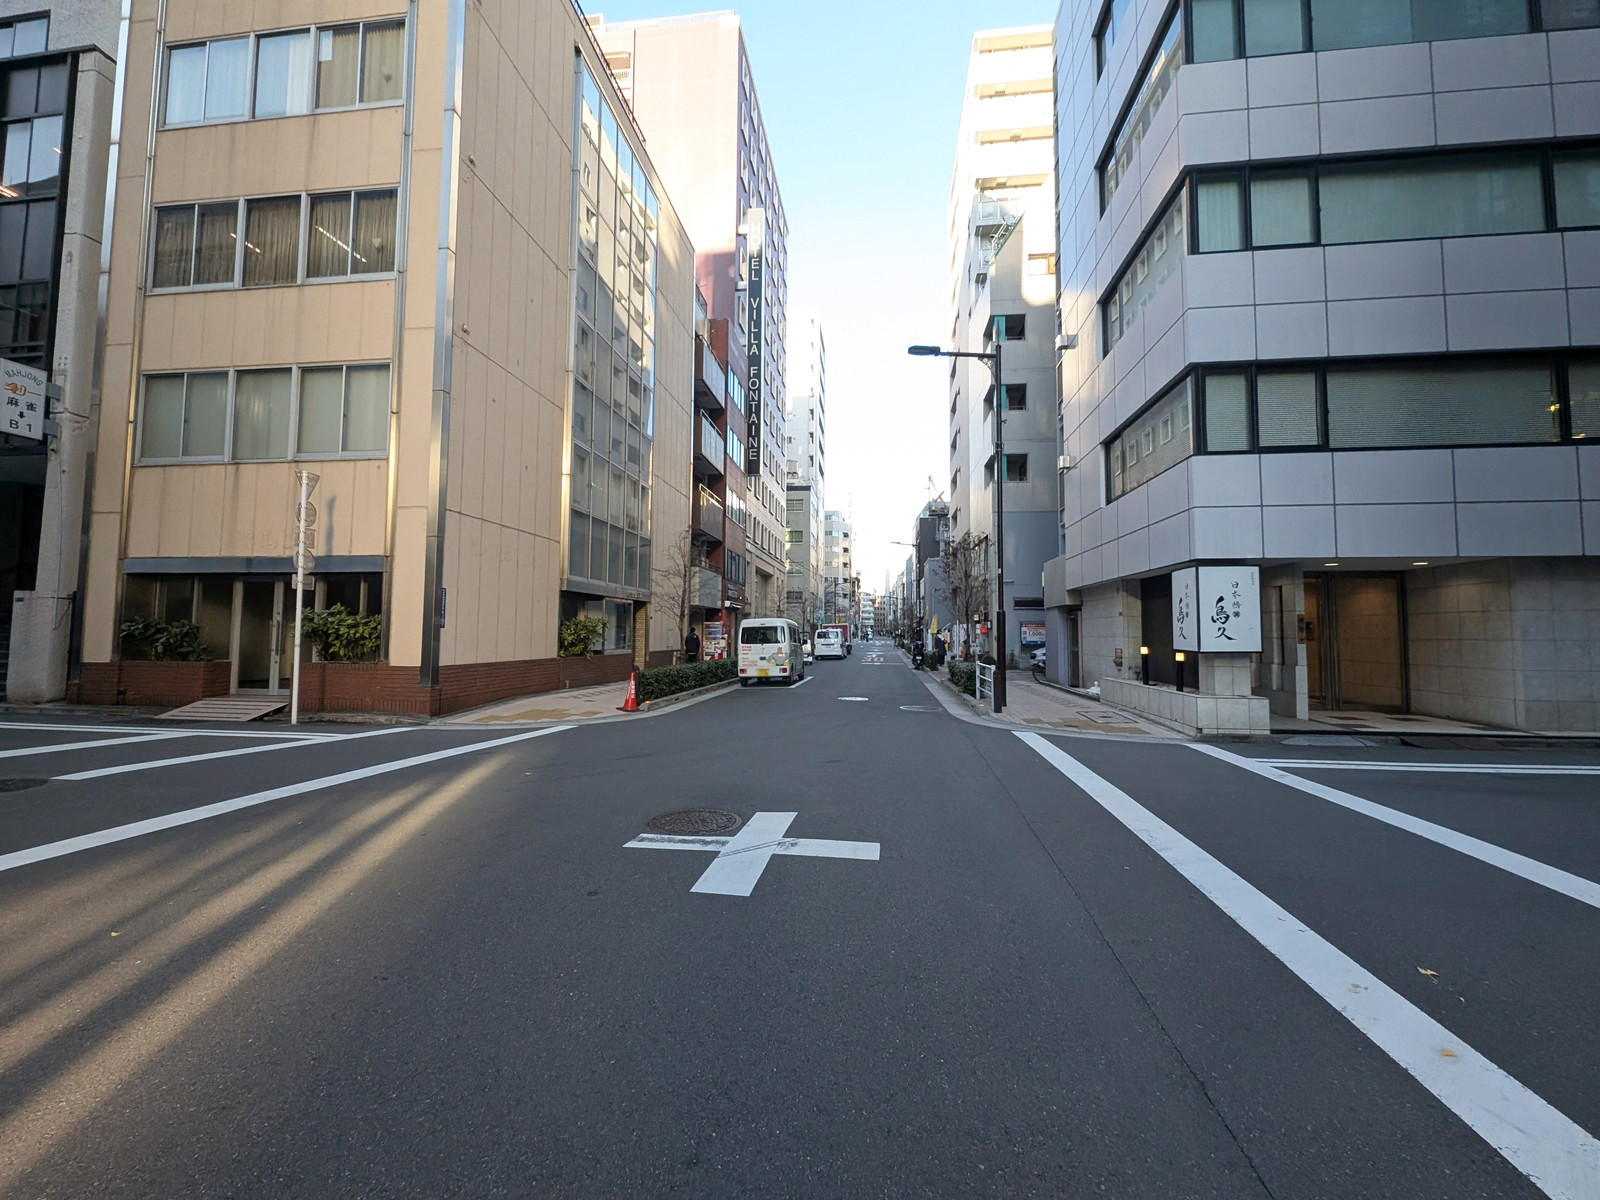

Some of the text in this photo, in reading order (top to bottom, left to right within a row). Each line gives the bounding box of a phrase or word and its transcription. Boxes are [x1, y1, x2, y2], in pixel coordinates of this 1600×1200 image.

[748, 222, 761, 460] HOTEL VILLA FONTAINE
[4, 369, 44, 387] MAHJONG
[6, 396, 38, 413] 麻雀
[1231, 580, 1242, 609] 日本橋
